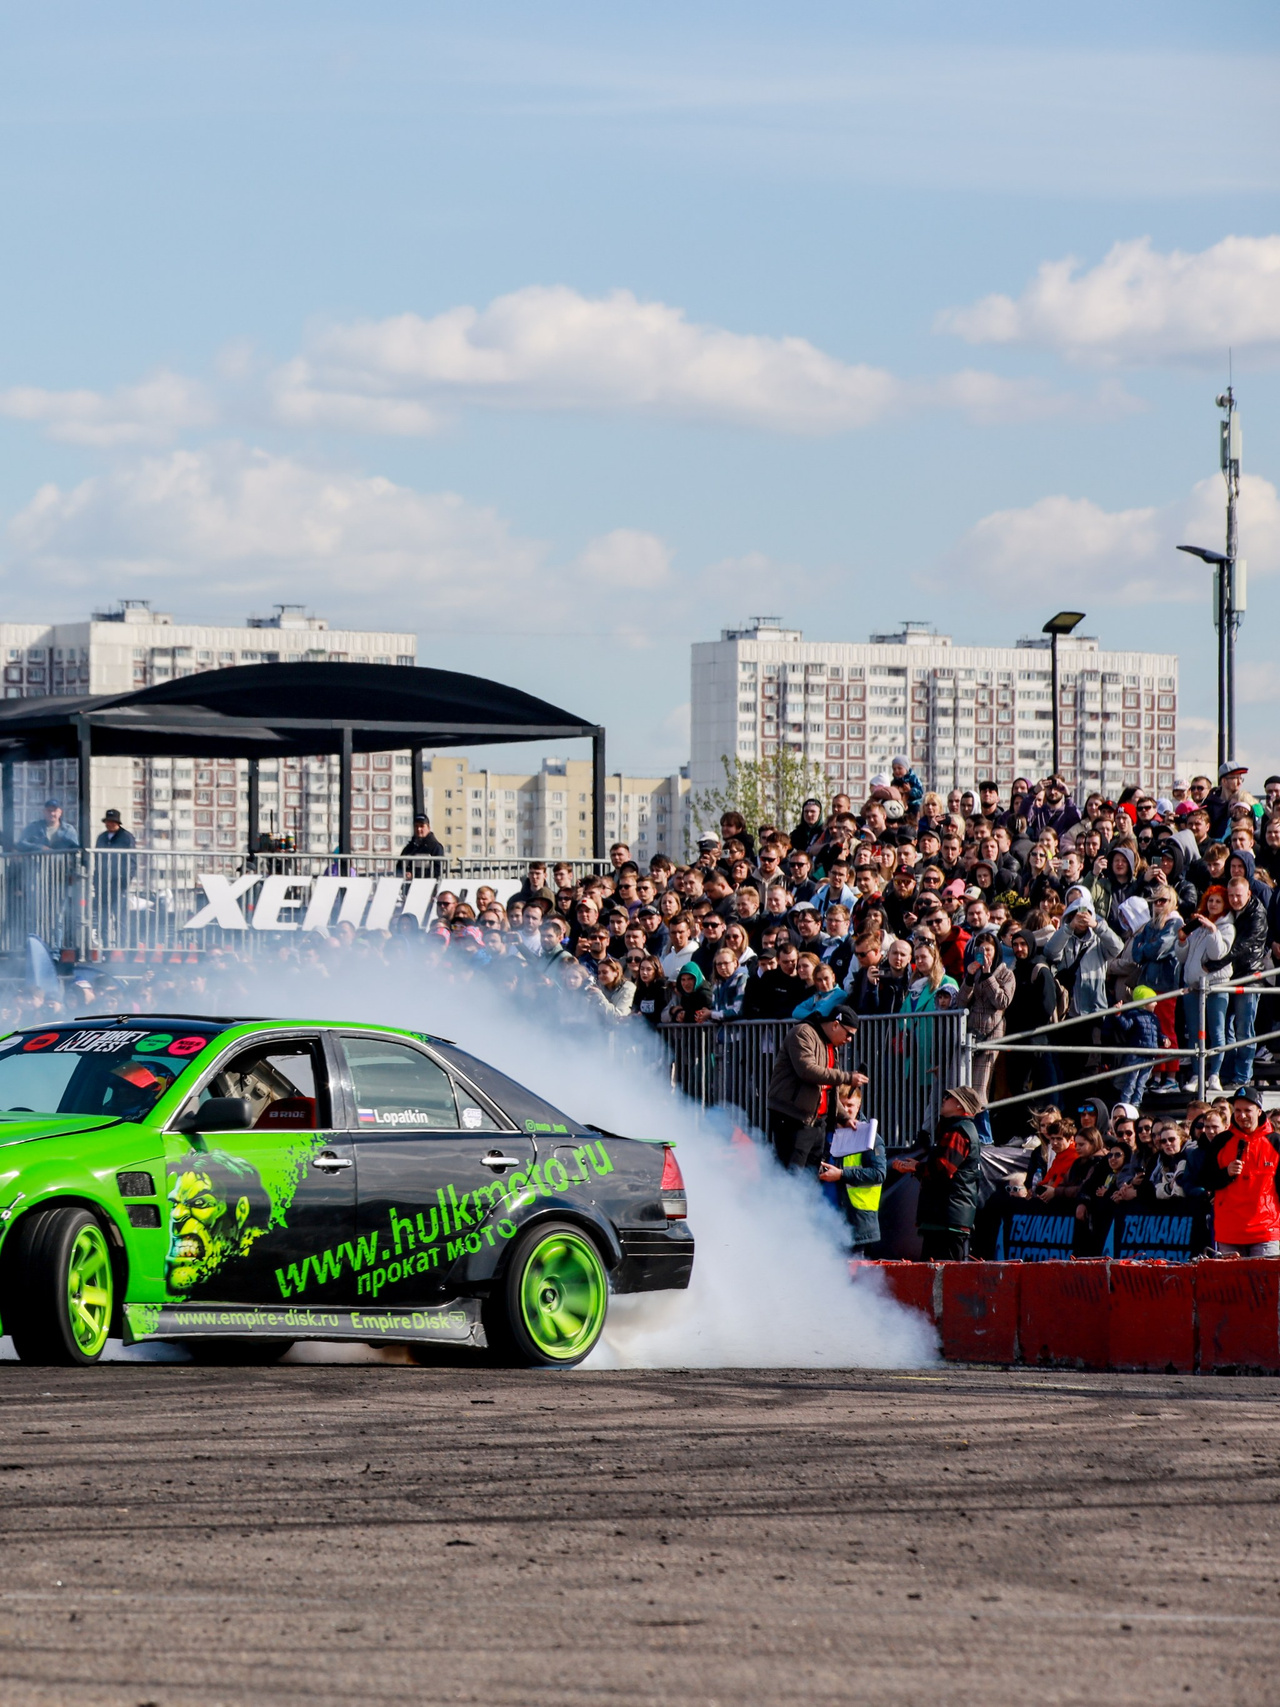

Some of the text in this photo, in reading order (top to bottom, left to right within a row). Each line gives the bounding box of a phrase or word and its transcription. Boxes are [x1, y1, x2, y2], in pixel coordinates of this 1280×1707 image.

[93, 1041, 130, 1053] FEST
[100, 1031, 151, 1043] DRIFT
[269, 1110, 306, 1118] BRIDE
[374, 1108, 428, 1126] Lopatkin
[275, 1141, 614, 1298] www.hulkmoto.ru
[1009, 1214, 1075, 1244] TSUNAMI
[1121, 1214, 1193, 1245] TSUNAMI
[357, 1247, 441, 1298] прокат
[175, 1308, 339, 1329] www.empire-disk.ru
